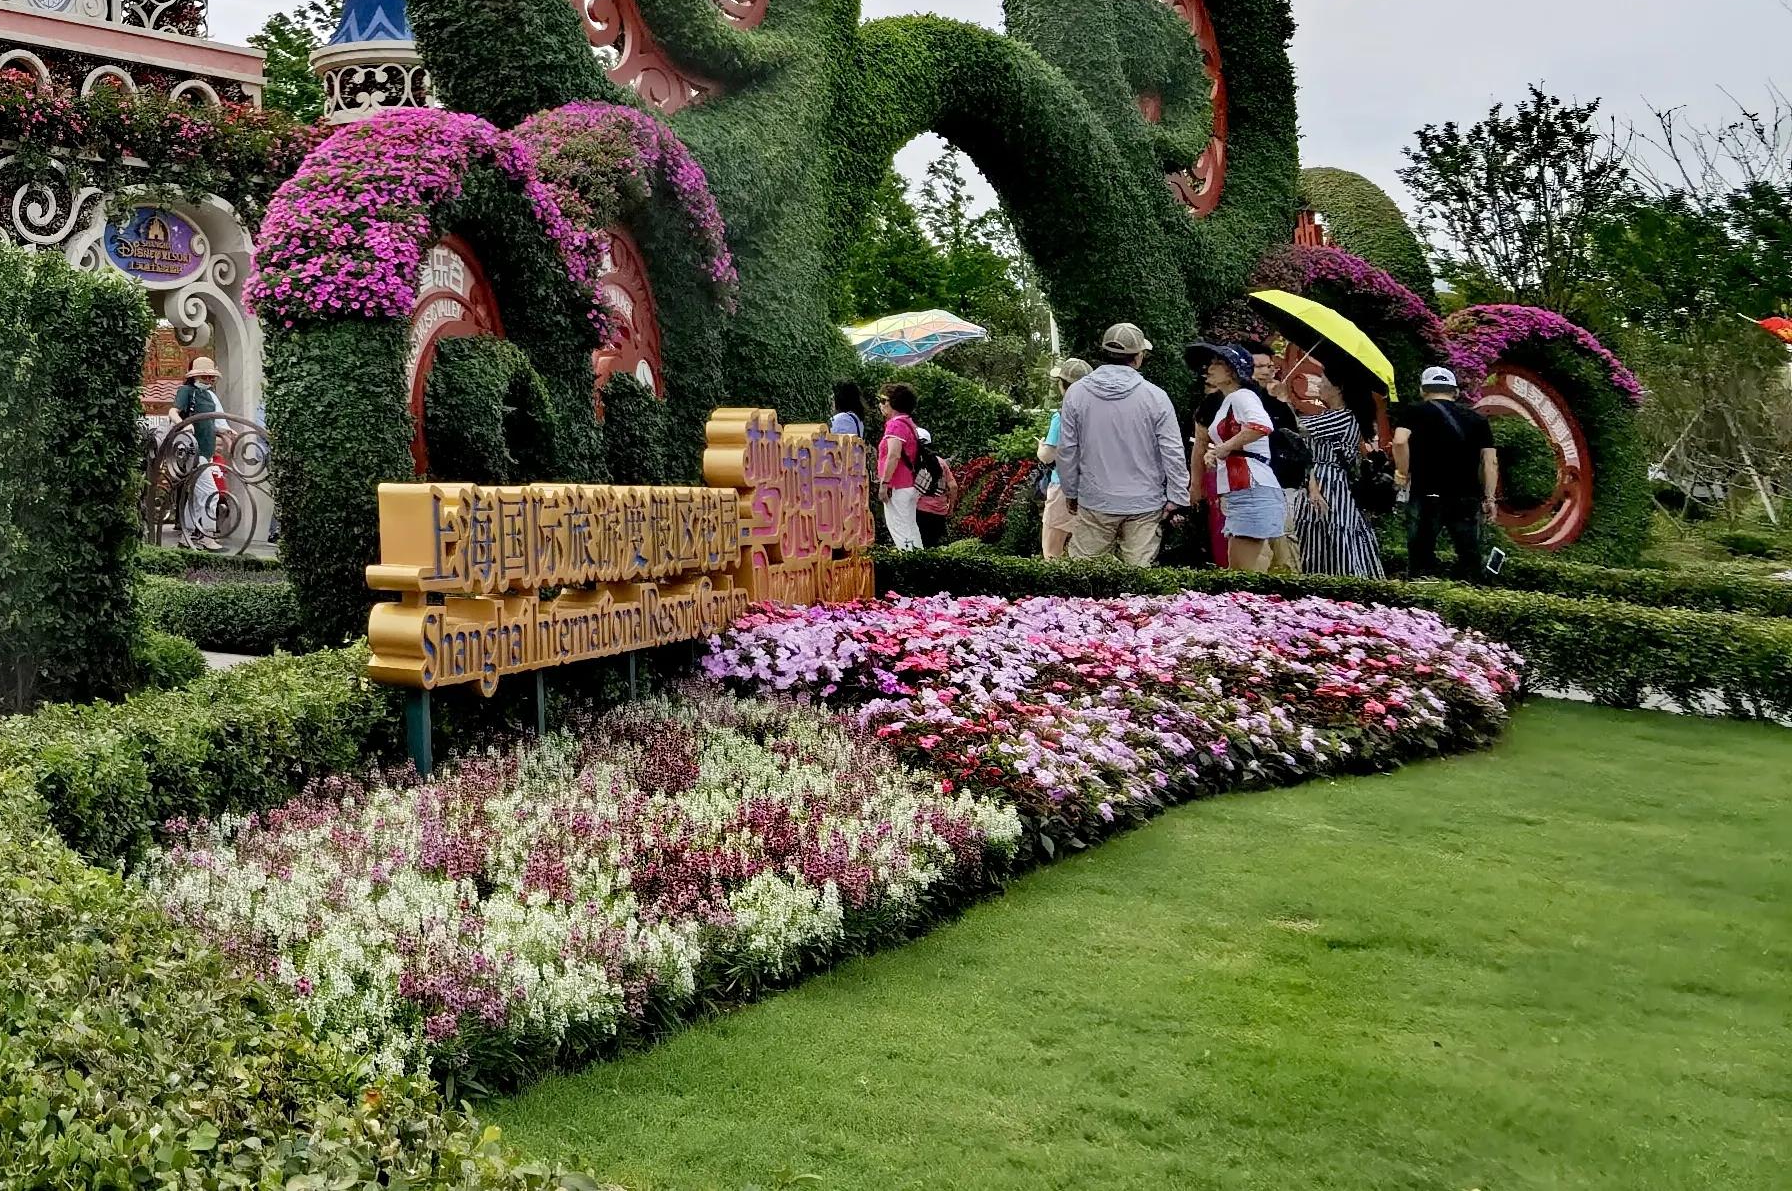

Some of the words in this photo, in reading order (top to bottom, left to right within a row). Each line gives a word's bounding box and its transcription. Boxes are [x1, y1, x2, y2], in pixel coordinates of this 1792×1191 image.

[421, 491, 739, 581] 上海国际旅游度假区花园
[422, 605, 529, 691] Shanghai
[531, 588, 644, 661] International
[645, 586, 698, 639] Resort
[699, 578, 749, 631] Garden
